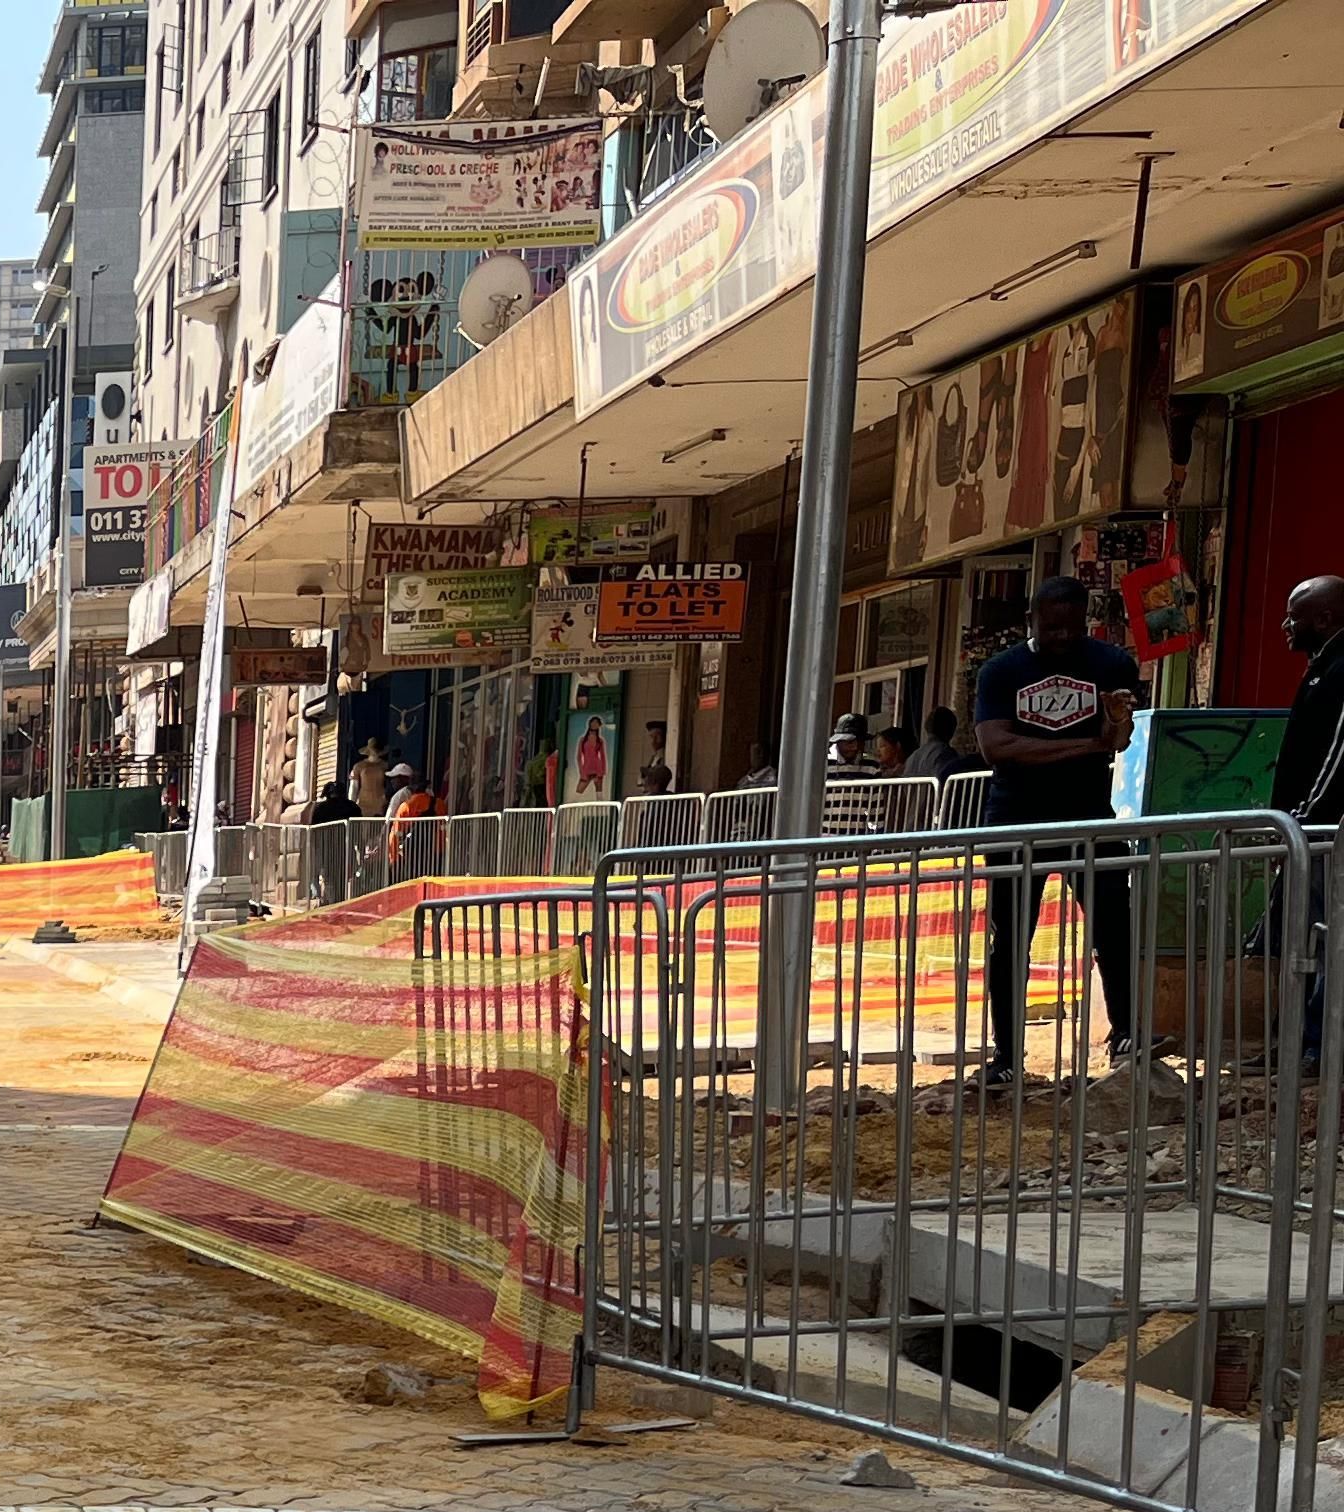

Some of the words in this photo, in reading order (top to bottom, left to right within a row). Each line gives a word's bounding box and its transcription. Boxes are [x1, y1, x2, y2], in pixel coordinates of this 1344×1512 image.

[934, 68, 943, 92] &
[886, 104, 928, 146] TRADING
[929, 55, 999, 118] ENTERPRISES
[889, 141, 949, 203] WHOLESALE
[951, 135, 961, 166] &
[961, 110, 1002, 160] RETAIL
[449, 163, 456, 174] &
[459, 162, 499, 175] CRECHE
[94, 452, 165, 466] APARTMENTS
[167, 450, 176, 460] &
[94, 464, 143, 499] TO
[90, 510, 123, 531] 011
[373, 527, 499, 553] KWAMAMA
[119, 567, 140, 575] CITY
[371, 552, 487, 577] THEKWINI
[635, 563, 743, 581] ALLIED
[426, 575, 477, 587] SUCCESS
[437, 586, 517, 602] ACADEMY
[537, 586, 593, 602] HOLLYWOOD
[625, 582, 722, 599] FLATS
[617, 601, 658, 617] TO
[669, 600, 727, 616] LET
[1028, 691, 1084, 714] UZZI
